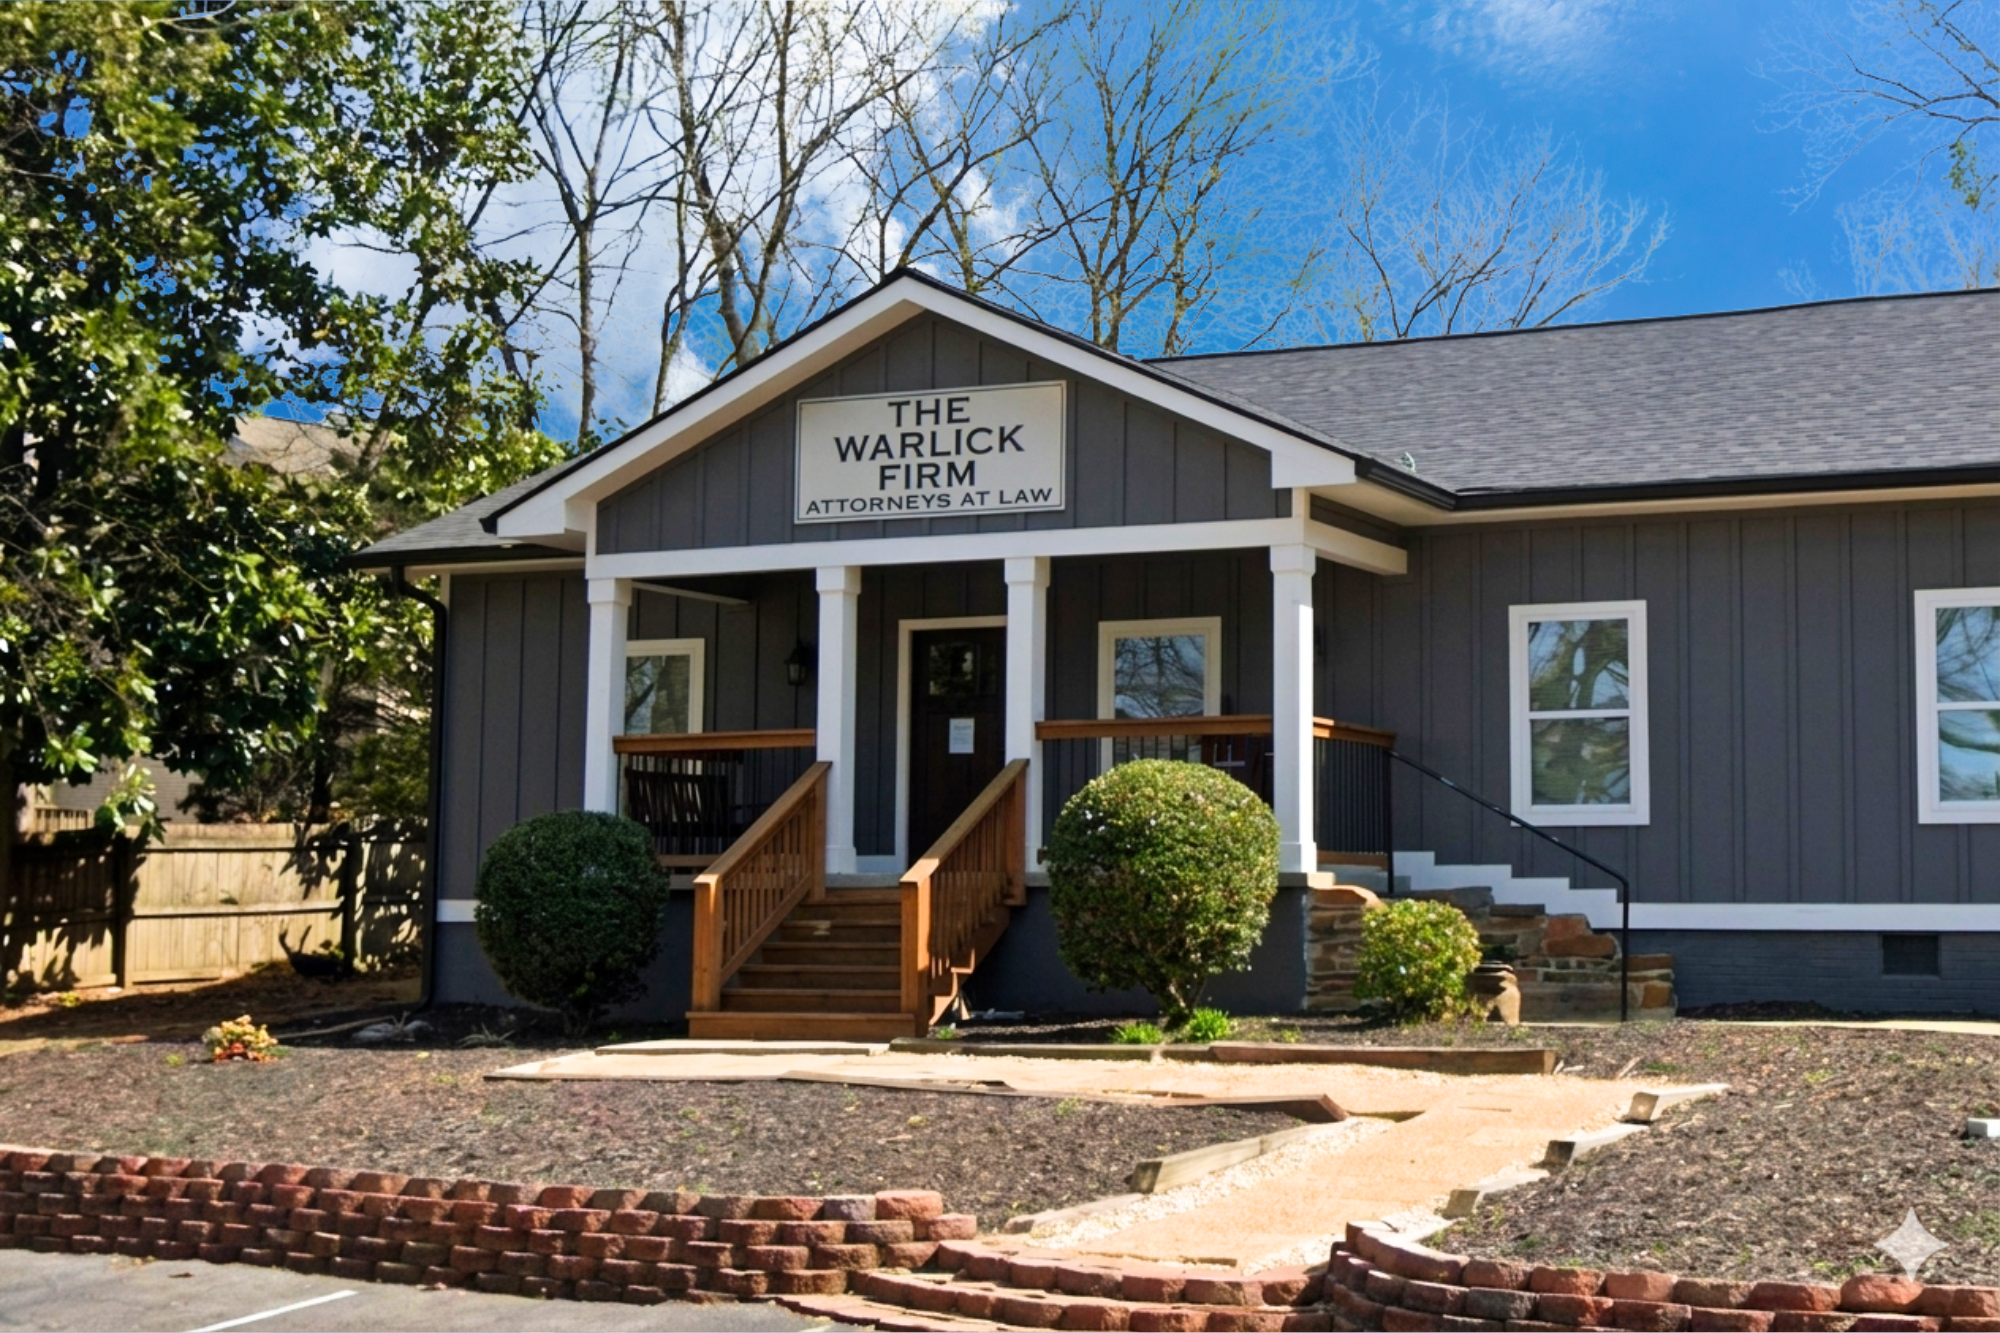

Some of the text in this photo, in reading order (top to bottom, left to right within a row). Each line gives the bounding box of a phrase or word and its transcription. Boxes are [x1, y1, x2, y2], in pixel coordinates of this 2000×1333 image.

[887, 396, 970, 428] THE
[834, 424, 1025, 462] WARLICK
[879, 460, 975, 490] FIRM
[806, 488, 1053, 515] ATTORNEYS AT LAW
